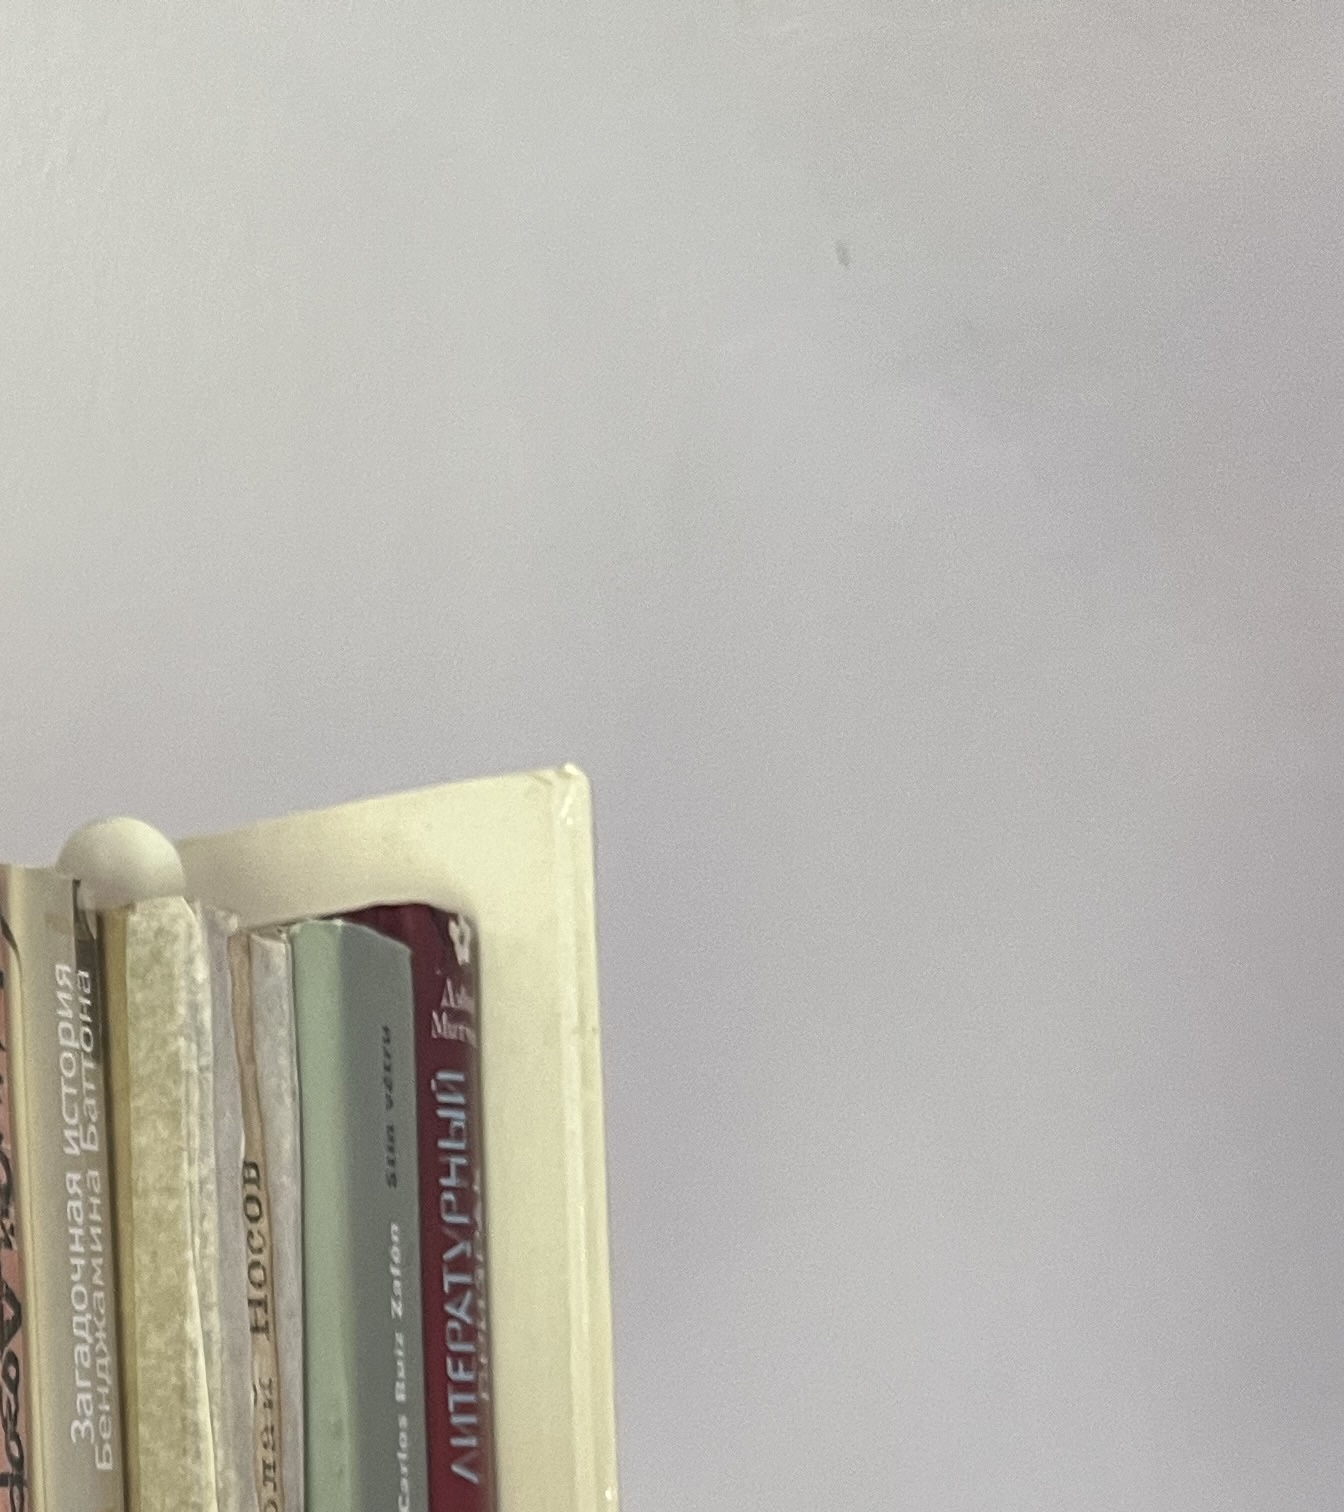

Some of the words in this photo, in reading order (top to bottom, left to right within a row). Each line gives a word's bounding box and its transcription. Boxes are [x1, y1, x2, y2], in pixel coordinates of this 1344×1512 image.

[55, 963, 81, 1157] история
[66, 1172, 95, 1444] Загадочная
[430, 1069, 480, 1484] ЛИТЕРАТУРНЫЙ
